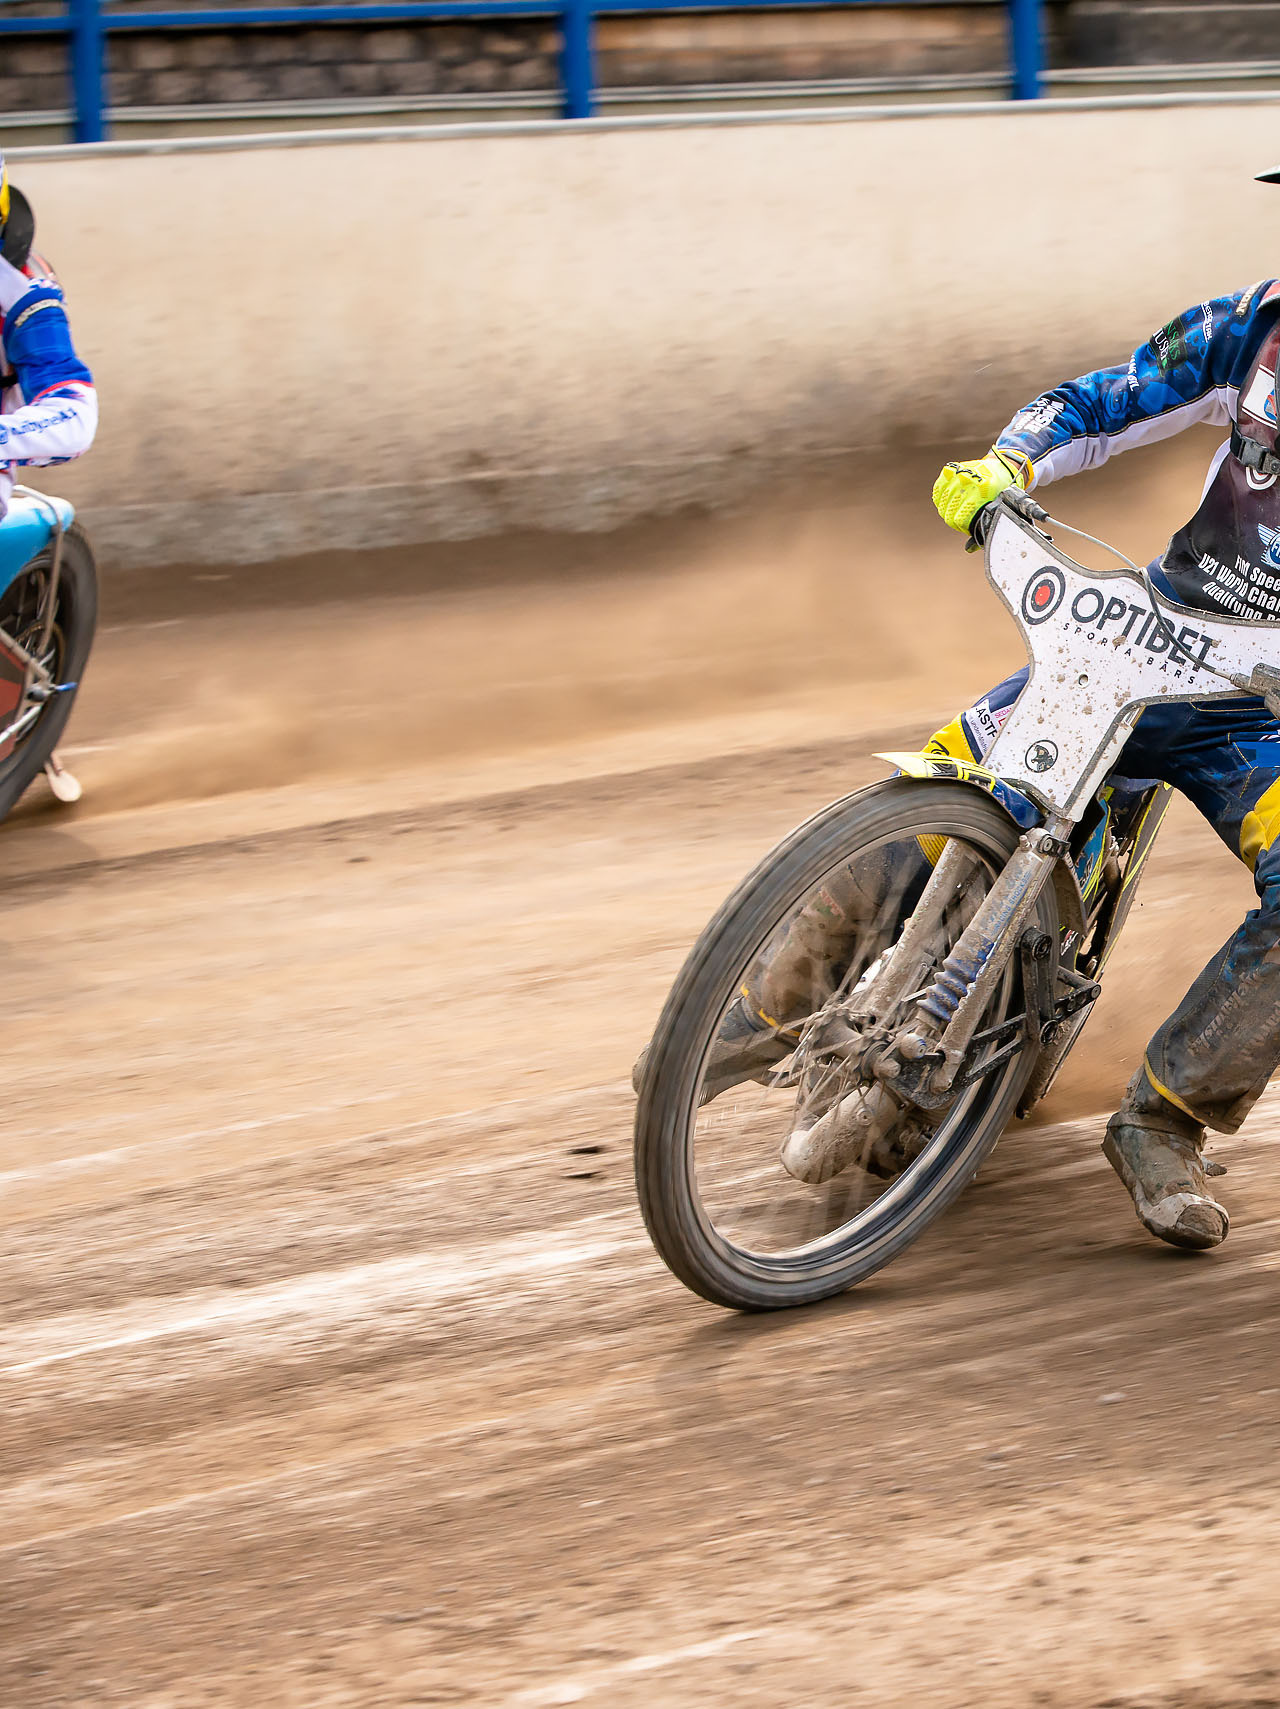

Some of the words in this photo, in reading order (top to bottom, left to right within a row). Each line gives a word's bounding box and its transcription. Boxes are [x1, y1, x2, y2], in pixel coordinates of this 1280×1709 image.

[1198, 552, 1220, 576] U21
[1215, 564, 1249, 598] World
[1234, 554, 1250, 577] FIM
[1071, 587, 1215, 673] OPTIBET
[1146, 655, 1196, 685] BĀRS
